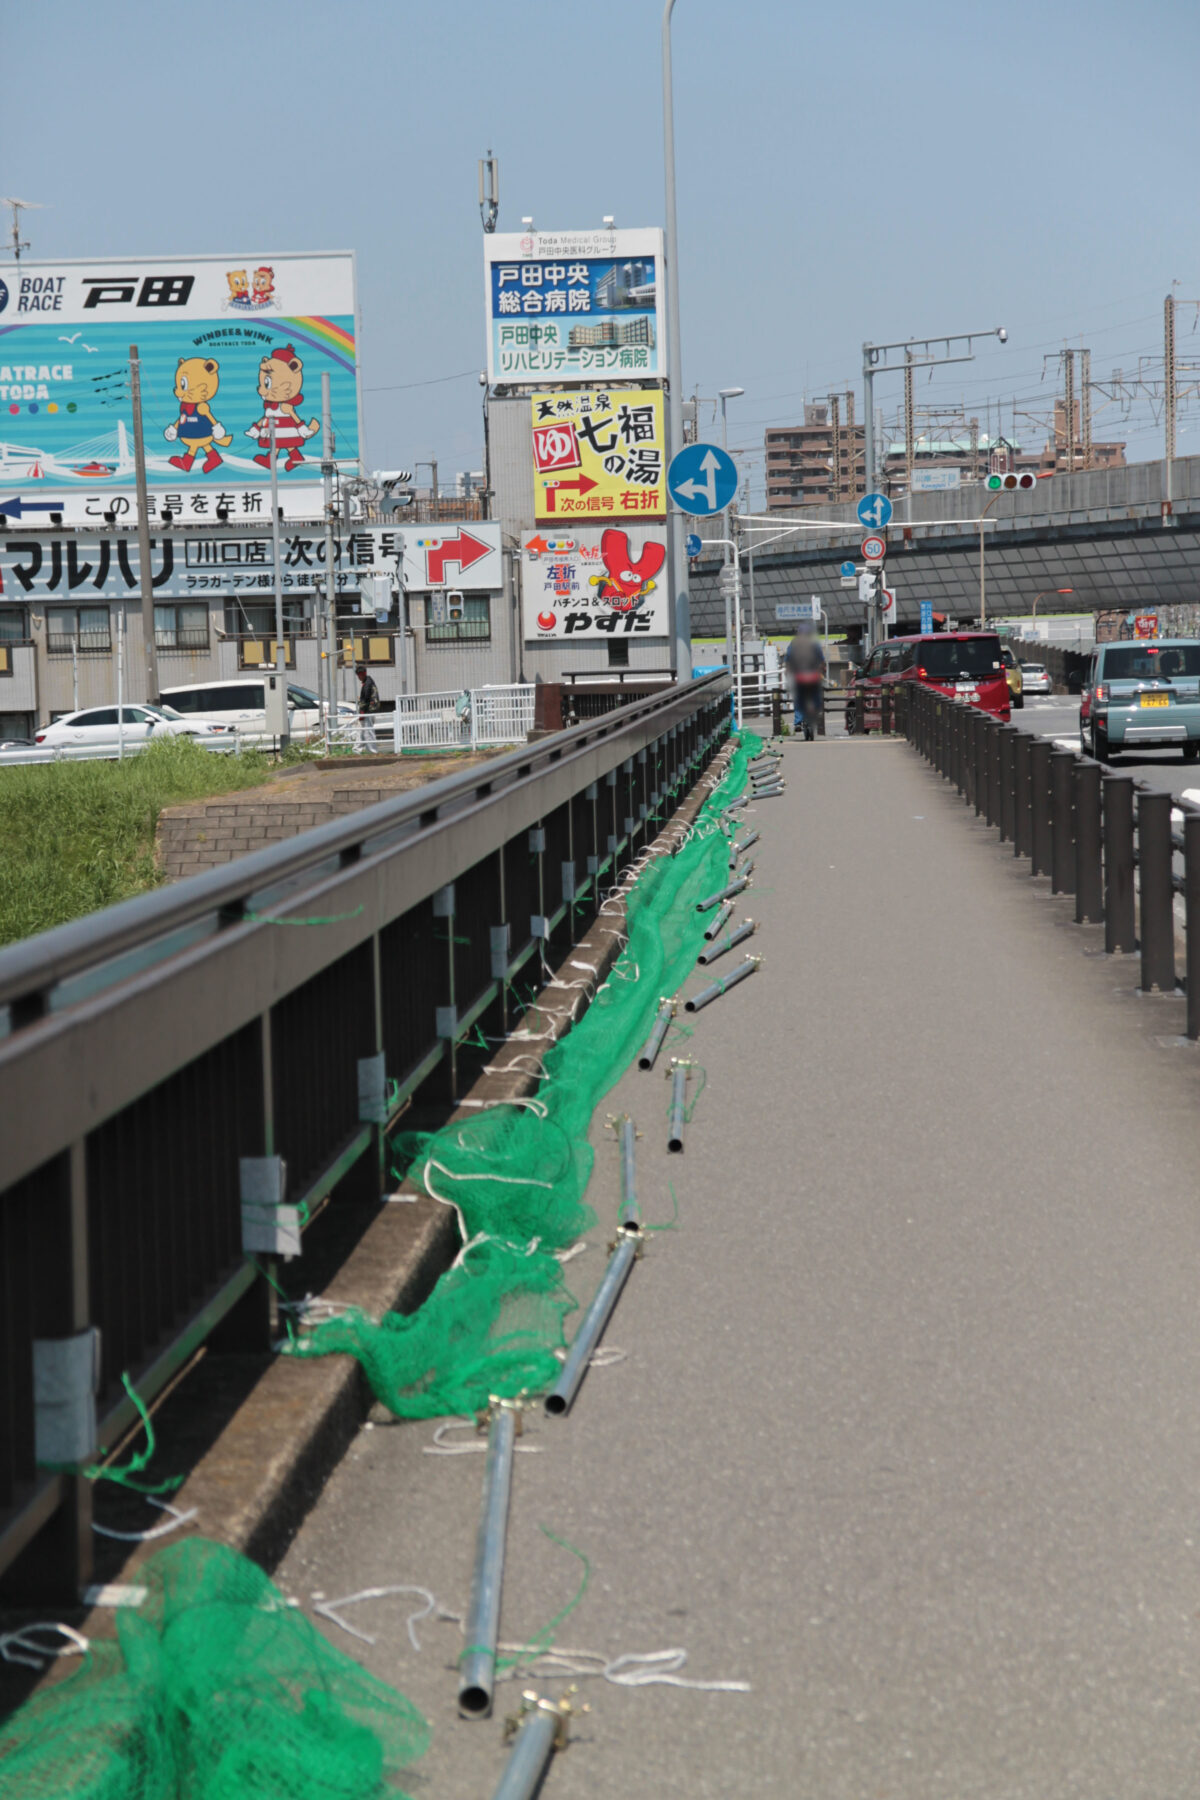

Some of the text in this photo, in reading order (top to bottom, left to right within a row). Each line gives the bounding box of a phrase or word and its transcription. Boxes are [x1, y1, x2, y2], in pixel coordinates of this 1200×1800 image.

[538, 235, 617, 245] Toda Medical Group
[538, 244, 617, 256] 戸田中央医科グループ
[20, 277, 66, 293] BOAT
[498, 262, 590, 288] 戸田中央
[17, 294, 64, 311] RACE
[81, 275, 195, 309] 戸田
[498, 289, 591, 314] 総合病院
[501, 324, 558, 346] 戸田中央
[502, 348, 648, 372] リハビリテーション病院
[0, 384, 50, 401] TODA
[534, 392, 613, 421] 天然温泉
[537, 428, 572, 465] ゆ
[85, 491, 264, 517] この信号を左折
[560, 489, 659, 512] 次の信号 右折
[866, 543, 881, 554] 50
[5, 533, 407, 592] マルハン 川口店 次の信号
[546, 564, 577, 580] 左折
[543, 582, 580, 592] 戸田駅前
[553, 597, 589, 608] パチンコ
[602, 595, 639, 607] スロット
